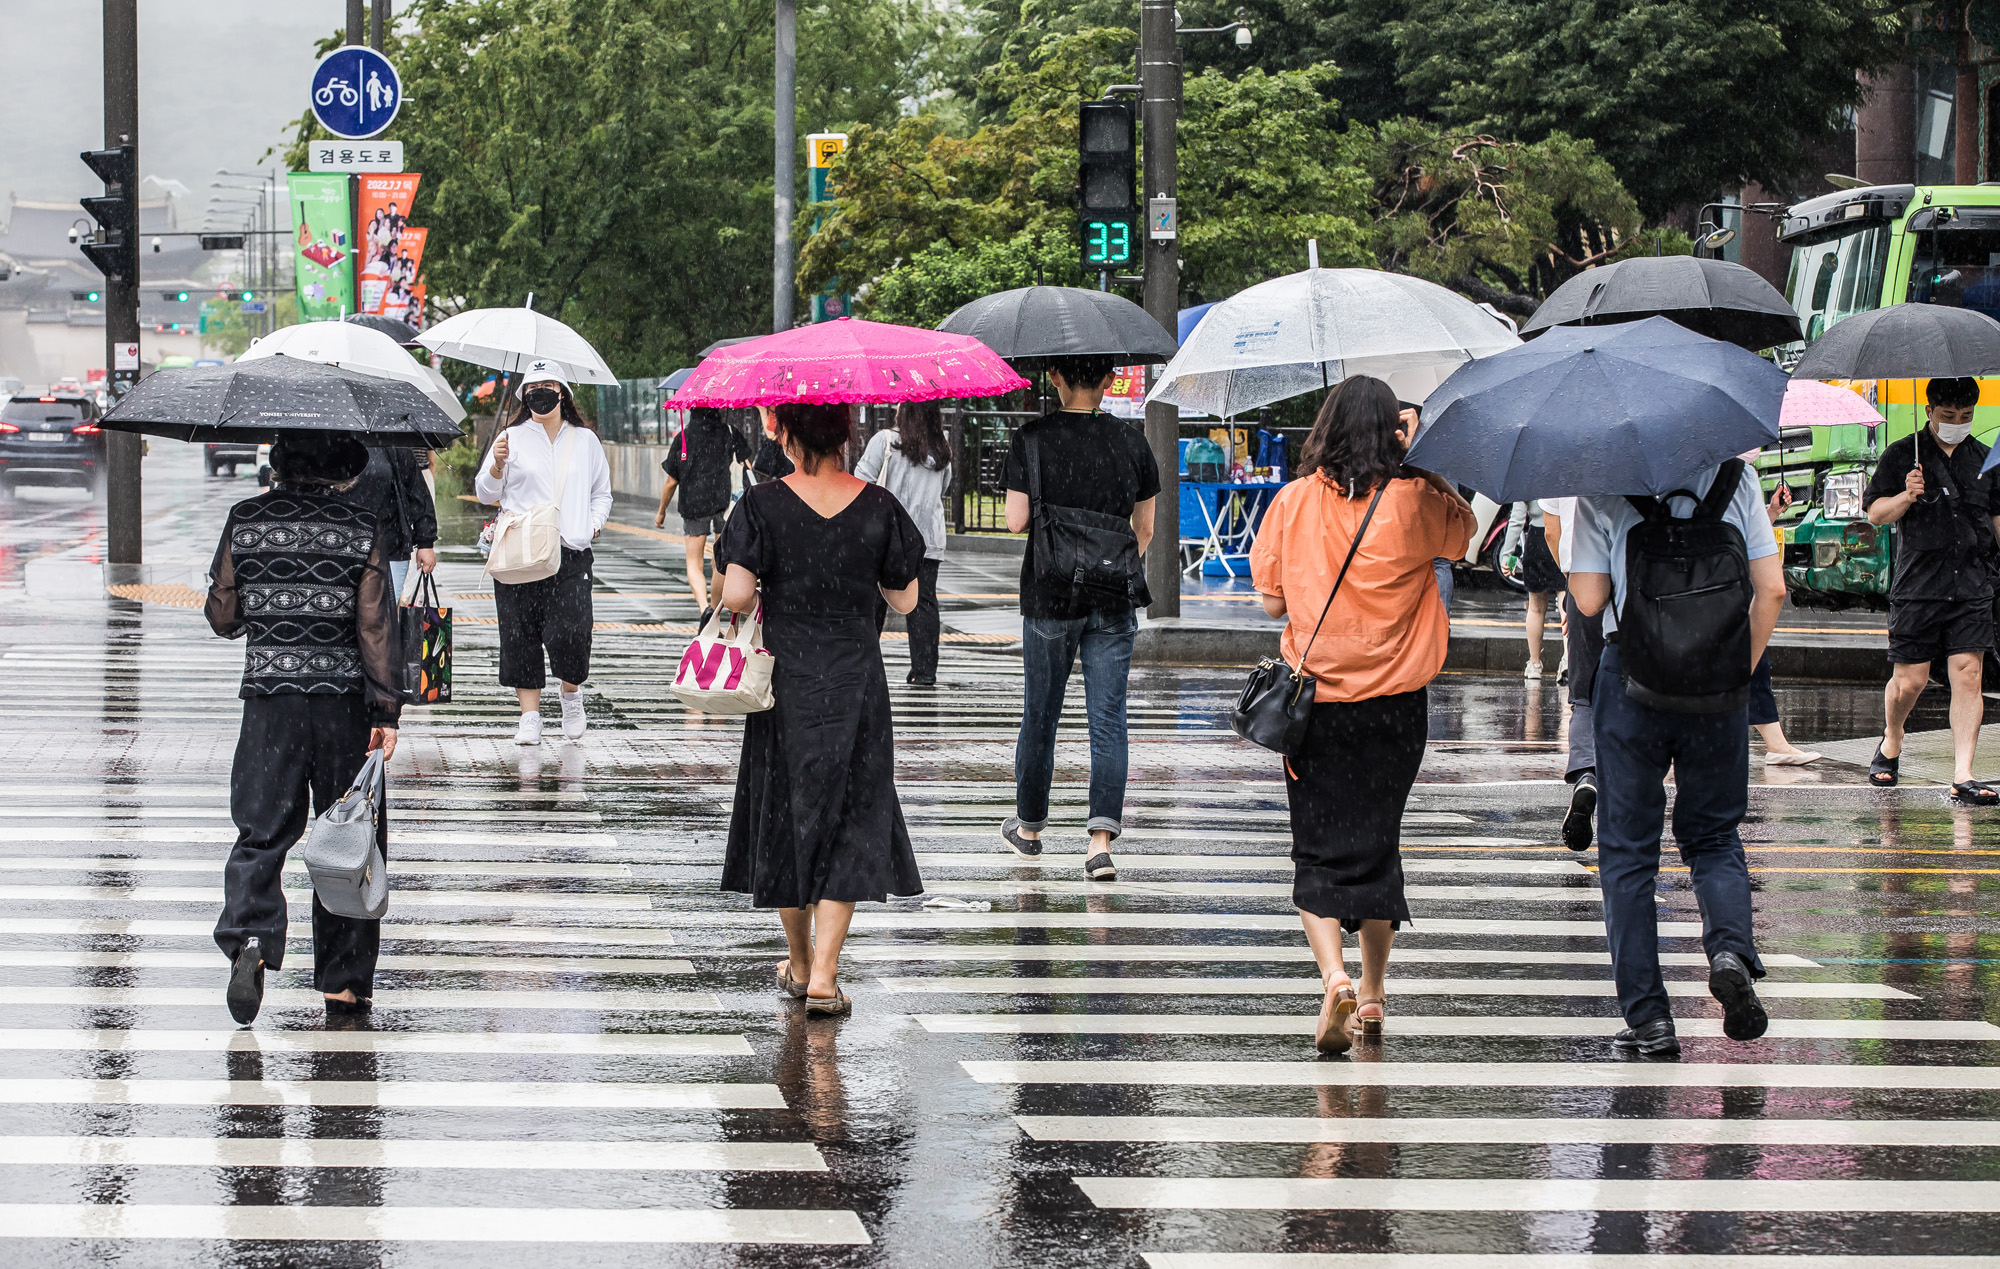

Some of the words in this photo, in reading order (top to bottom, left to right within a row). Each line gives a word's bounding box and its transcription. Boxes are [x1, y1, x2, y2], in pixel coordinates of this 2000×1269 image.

[319, 149, 393, 164] 겸용도로
[366, 180, 402, 190] 2022.7.7
[1089, 222, 1129, 261] 33
